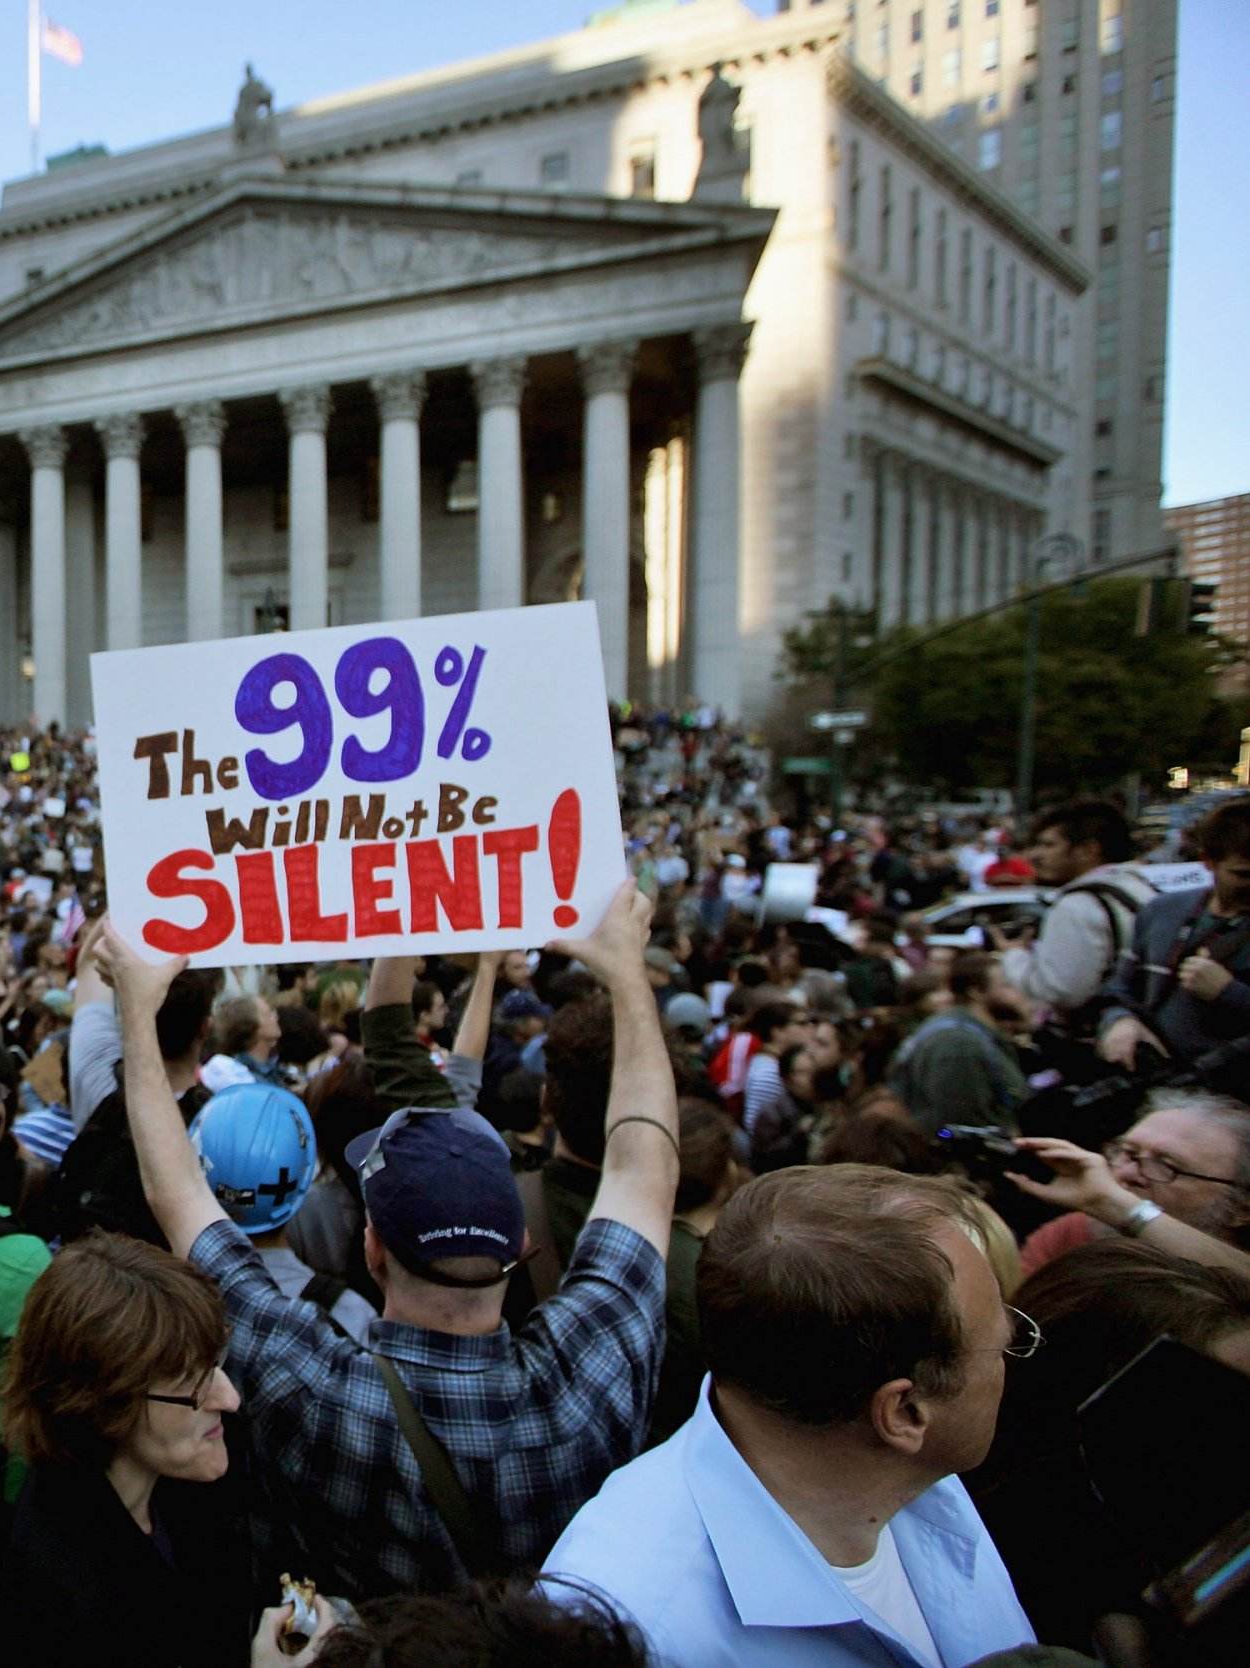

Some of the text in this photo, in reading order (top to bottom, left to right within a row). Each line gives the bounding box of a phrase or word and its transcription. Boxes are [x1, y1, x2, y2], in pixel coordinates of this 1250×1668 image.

[133, 636, 492, 800] The 99%
[142, 788, 582, 954] SILENT!
[206, 783, 498, 855] Will Not Be
[453, 1226, 467, 1236] for
